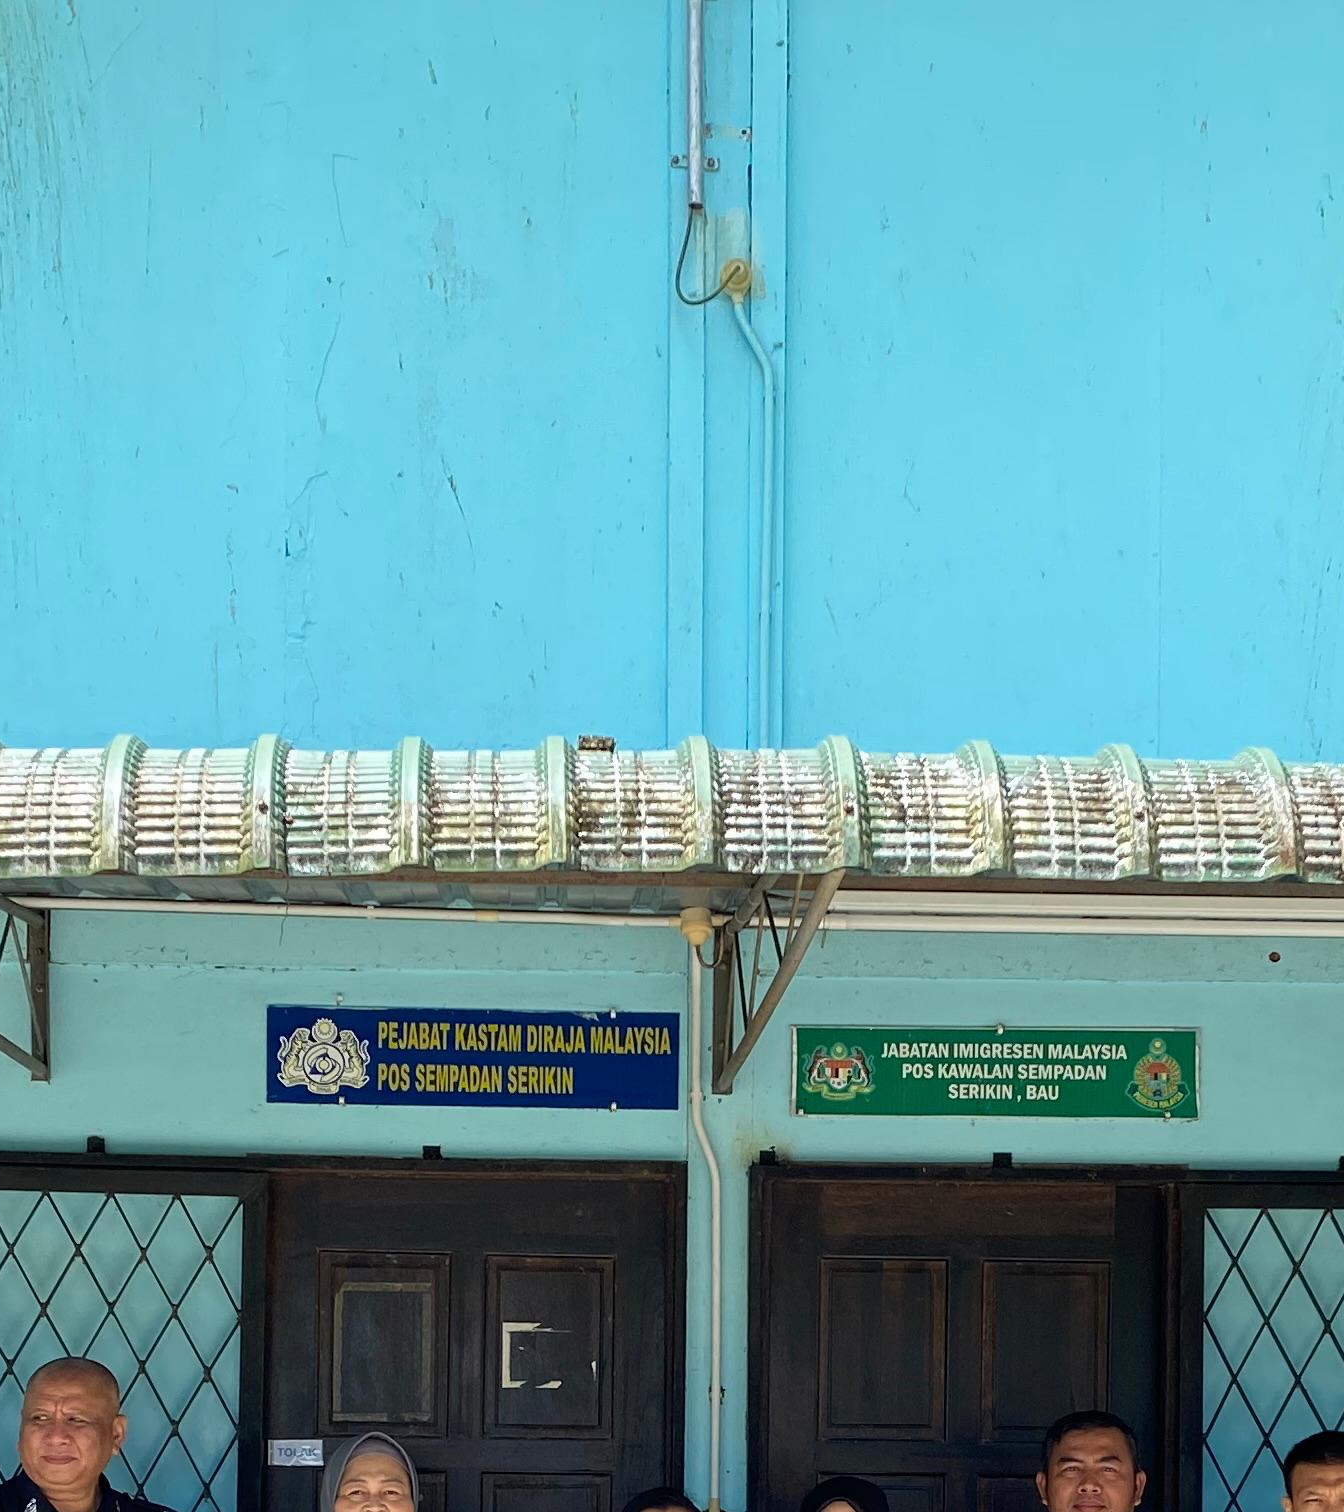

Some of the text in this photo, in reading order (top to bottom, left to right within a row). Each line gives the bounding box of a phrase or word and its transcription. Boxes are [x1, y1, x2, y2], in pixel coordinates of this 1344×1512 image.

[378, 1022, 672, 1056] PEJABAT KASTAM DIRAJA MALAYSIA
[881, 1043, 1128, 1060] JABATAN IMIGRESEN MALAYSIA
[378, 1064, 574, 1094] POS SEMPADAN SERIKIN
[902, 1063, 1107, 1080] POS KAWALAN SEMPADAN
[948, 1084, 1012, 1100] SERIKIN
[1027, 1085, 1059, 1100] BAU
